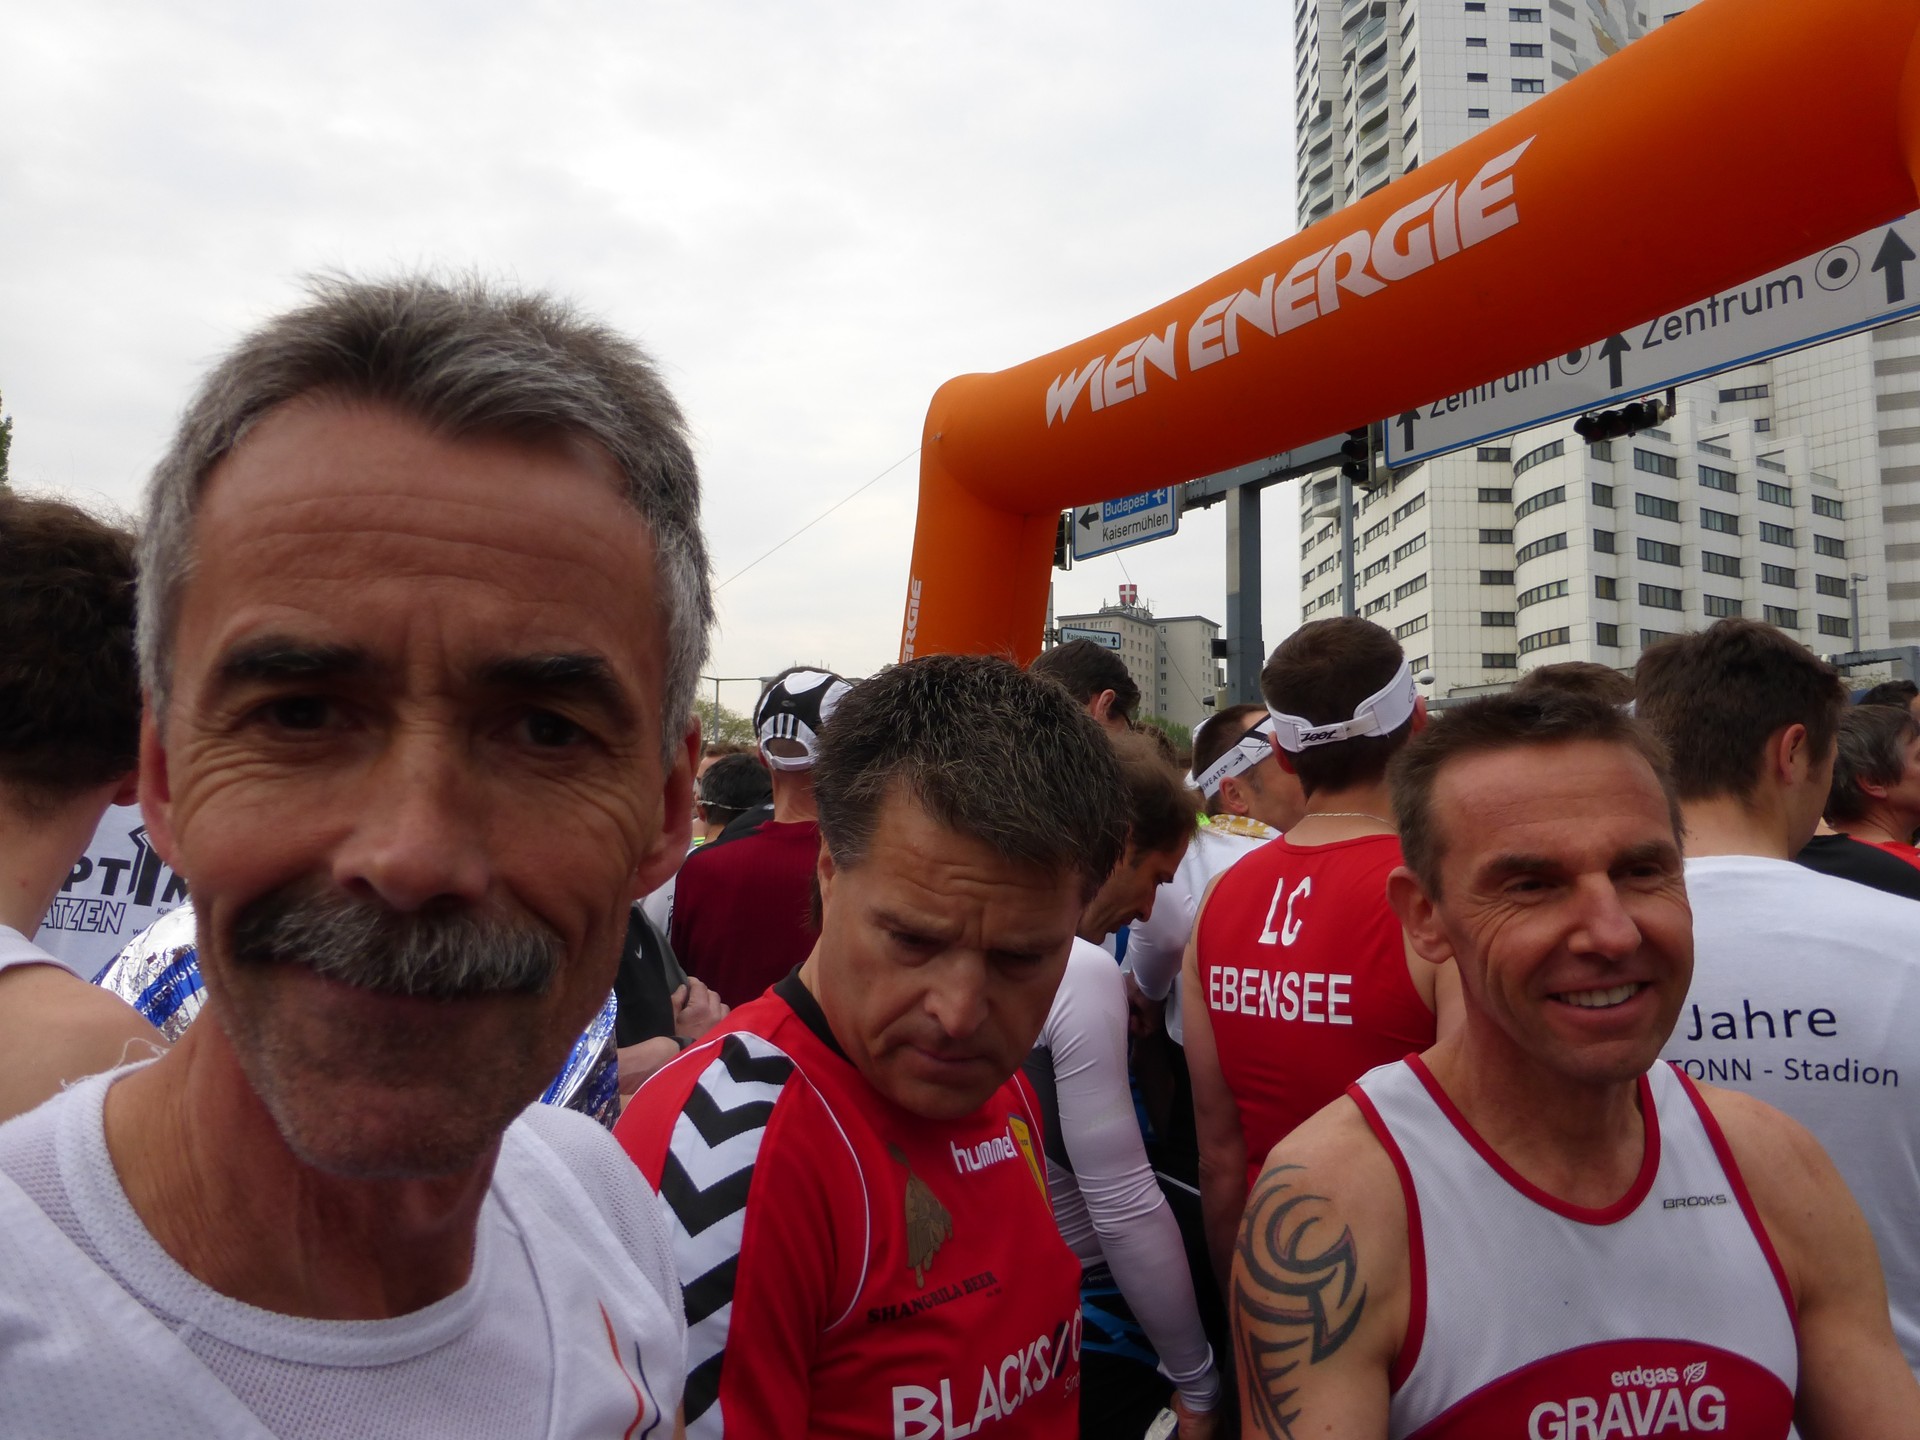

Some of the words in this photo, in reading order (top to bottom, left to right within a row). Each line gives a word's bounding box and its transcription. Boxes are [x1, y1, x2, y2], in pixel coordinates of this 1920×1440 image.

[1046, 321, 1178, 429] WIEN
[1188, 135, 1537, 373] ENERGIE
[1642, 274, 1804, 350] Zentrum
[1105, 491, 1150, 517] Budapest
[1102, 513, 1169, 542] Kaisermühlen
[1257, 875, 1312, 947] LC
[1209, 965, 1353, 1025] EBENSEE
[1687, 999, 1838, 1042] Jahre
[1783, 1058, 1900, 1088] Stadion
[950, 1126, 1018, 1175] hummel
[1662, 1194, 1728, 1210] BROOKS
[961, 1270, 998, 1295] BEER
[1611, 1365, 1679, 1388] erdgas
[1527, 1385, 1726, 1440] GRAVAG
